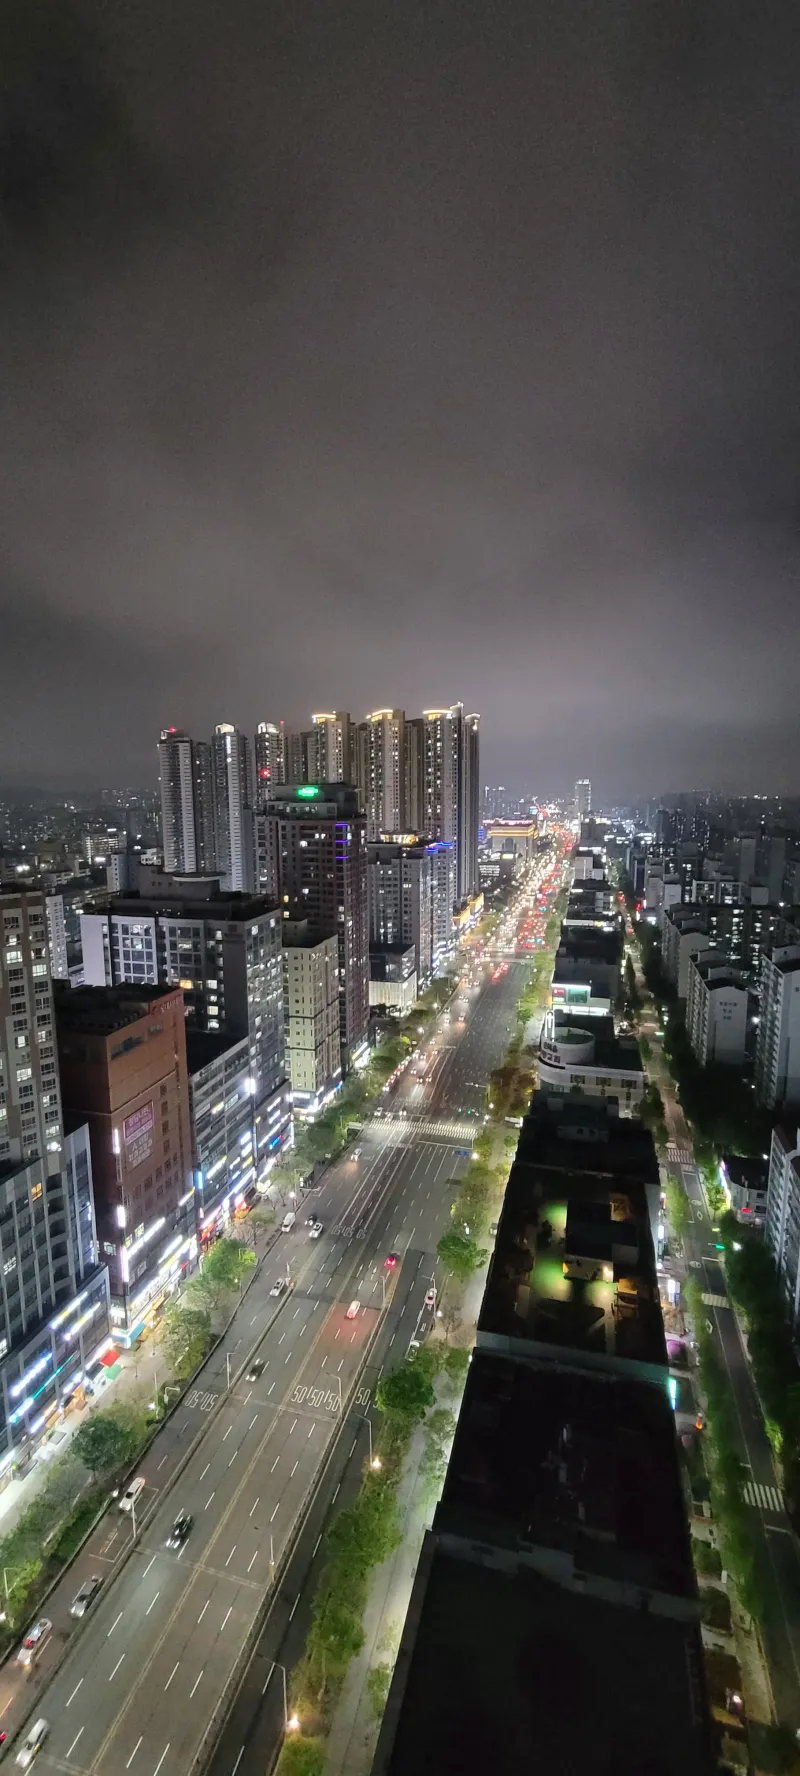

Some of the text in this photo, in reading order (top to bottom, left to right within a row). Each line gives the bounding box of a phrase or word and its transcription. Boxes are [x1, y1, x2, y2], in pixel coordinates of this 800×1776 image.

[291, 1385, 341, 1411] 50 50 50
[355, 1387, 371, 1405] 50
